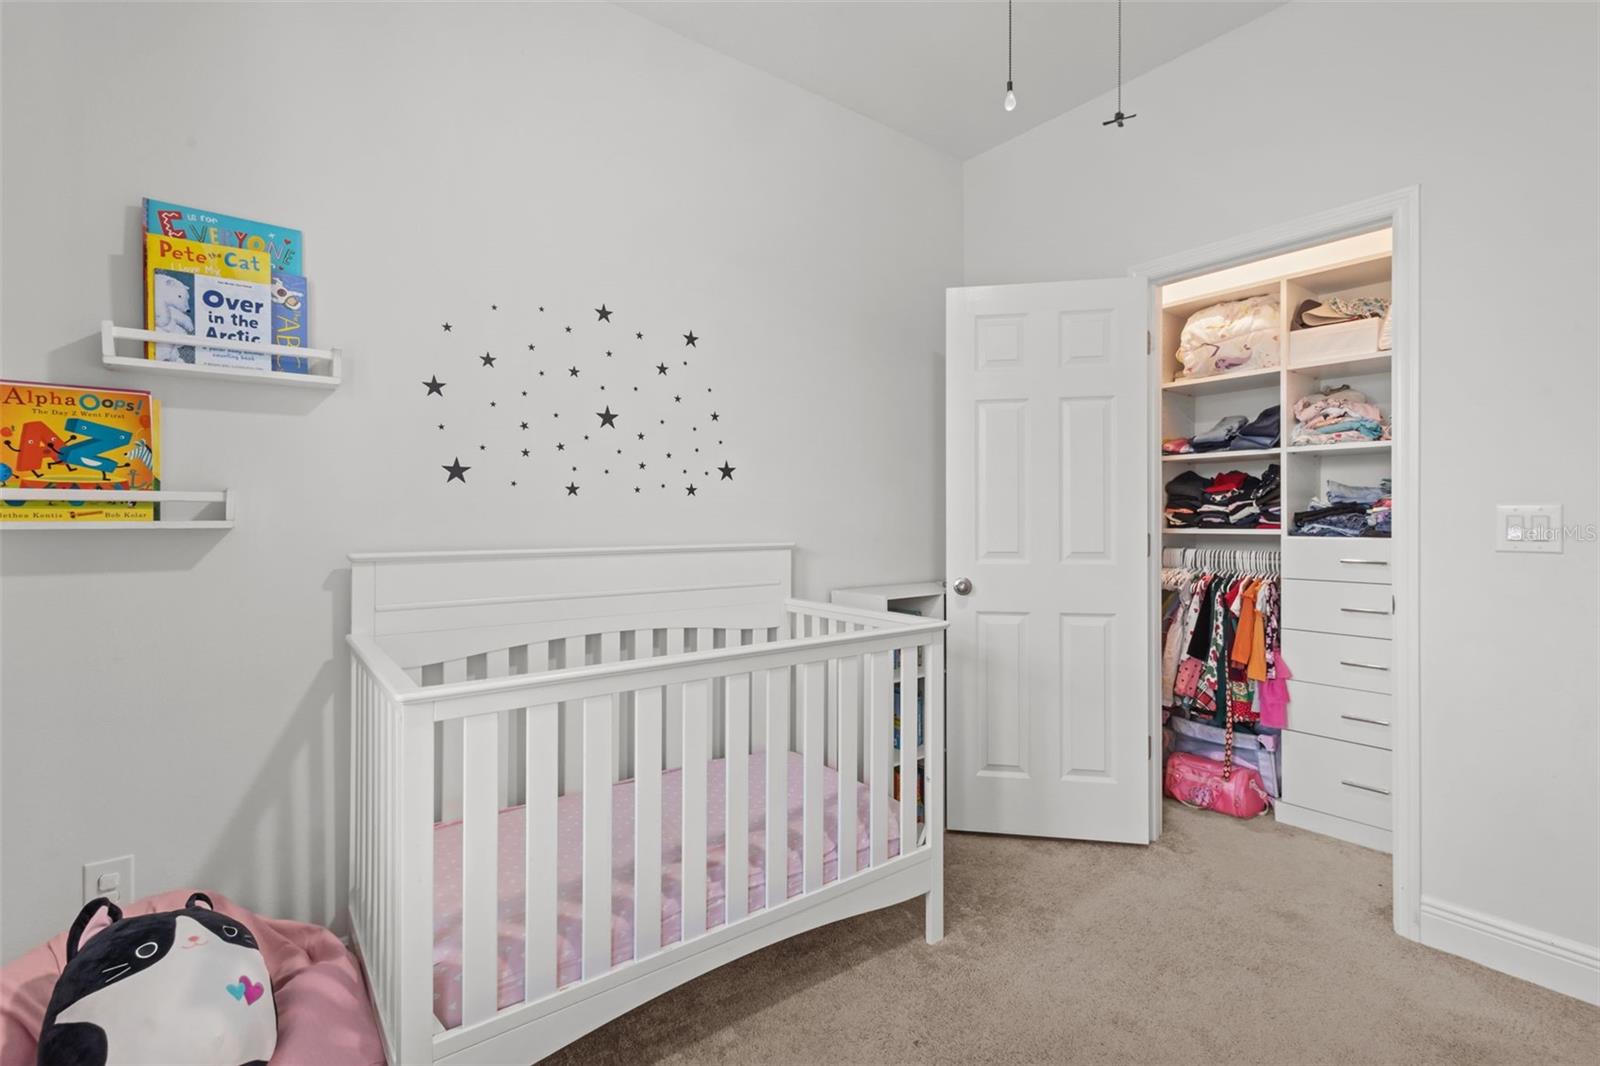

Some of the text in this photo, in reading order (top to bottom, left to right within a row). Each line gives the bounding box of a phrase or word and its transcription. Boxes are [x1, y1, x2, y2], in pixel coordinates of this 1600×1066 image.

[159, 239, 207, 264] Pete
[224, 251, 261, 272] Cat
[202, 289, 264, 314] Over
[208, 310, 259, 329] in the
[51, 409, 68, 417] Day
[80, 410, 102, 418] Went
[104, 412, 126, 420] First
